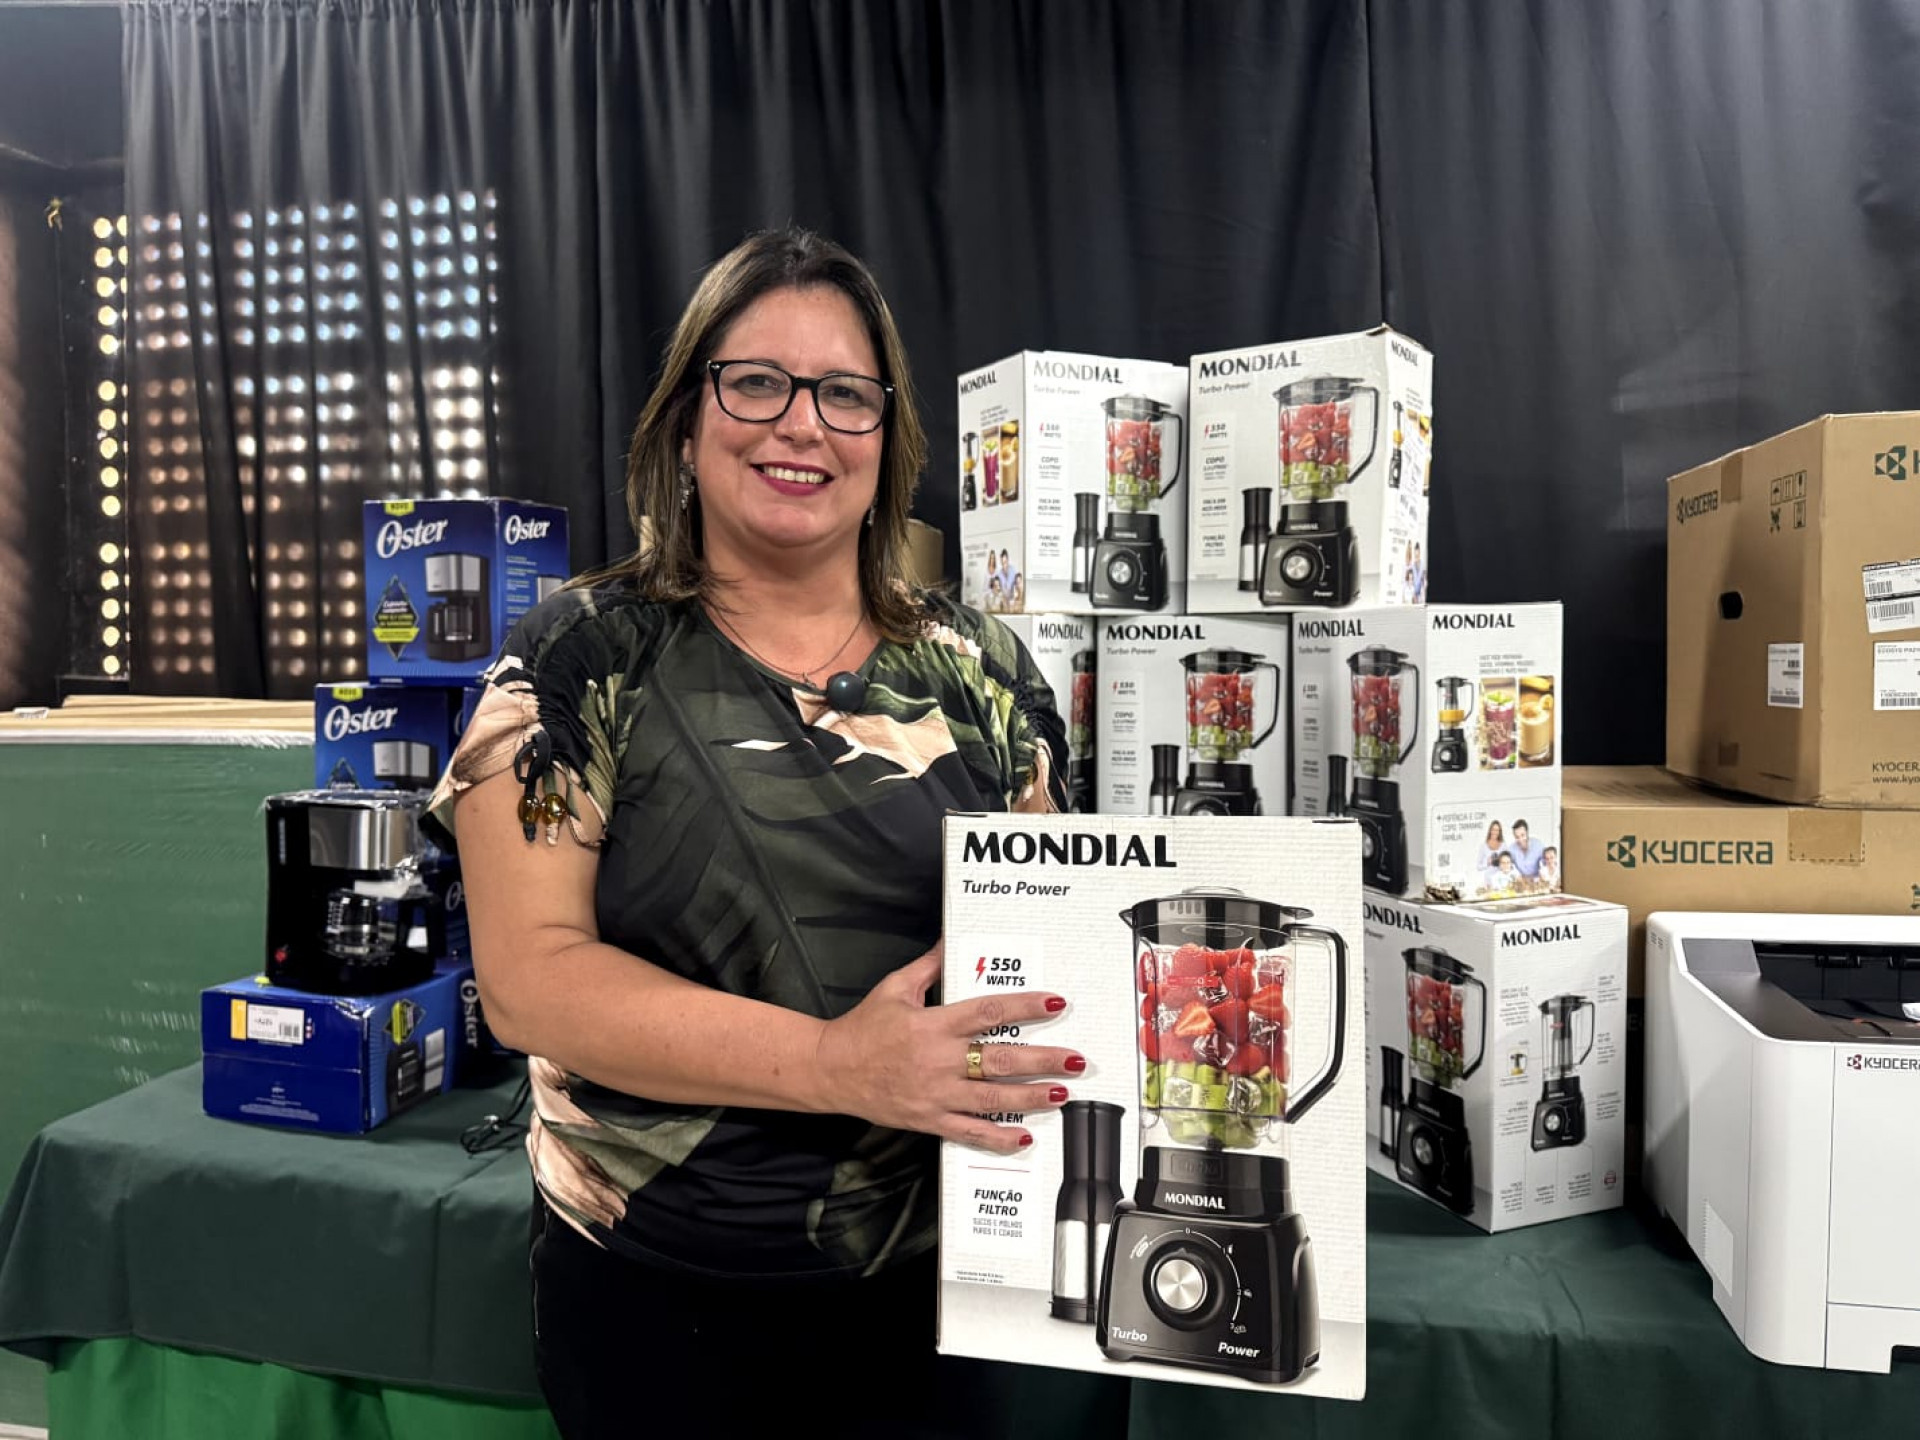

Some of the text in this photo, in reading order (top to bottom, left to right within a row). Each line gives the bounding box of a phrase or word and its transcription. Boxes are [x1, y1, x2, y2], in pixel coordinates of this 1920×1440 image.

[1033, 360, 1123, 384] MONDIAL
[1199, 350, 1302, 379] MONDIAL
[960, 370, 997, 395] MONDIAL
[376, 519, 449, 558] Oster
[505, 514, 551, 546] Oster
[1038, 623, 1085, 641] MONDIAL
[1299, 618, 1365, 639] MONDIAL
[1432, 612, 1516, 630] MONDIAL
[1106, 624, 1206, 641] MONDIAL
[324, 704, 398, 742] Oster
[1872, 761, 1920, 773] KYOCER
[962, 831, 1177, 868] MONDIAL
[1642, 840, 1773, 865] KYOCERA
[962, 880, 1071, 897] Turbo Power
[1363, 902, 1423, 934] ONDIAL
[1501, 924, 1581, 948] MONDIAL
[990, 957, 1021, 972] 550
[986, 975, 1026, 987] WATTS
[460, 978, 480, 1049] Oster
[1864, 1056, 1920, 1070] KYOCER
[974, 1188, 1023, 1204] FUNÇÃO
[1164, 1191, 1226, 1210] MONDIAL
[978, 1203, 1018, 1217] FILTRO
[1112, 1326, 1260, 1358] Turbo Power
